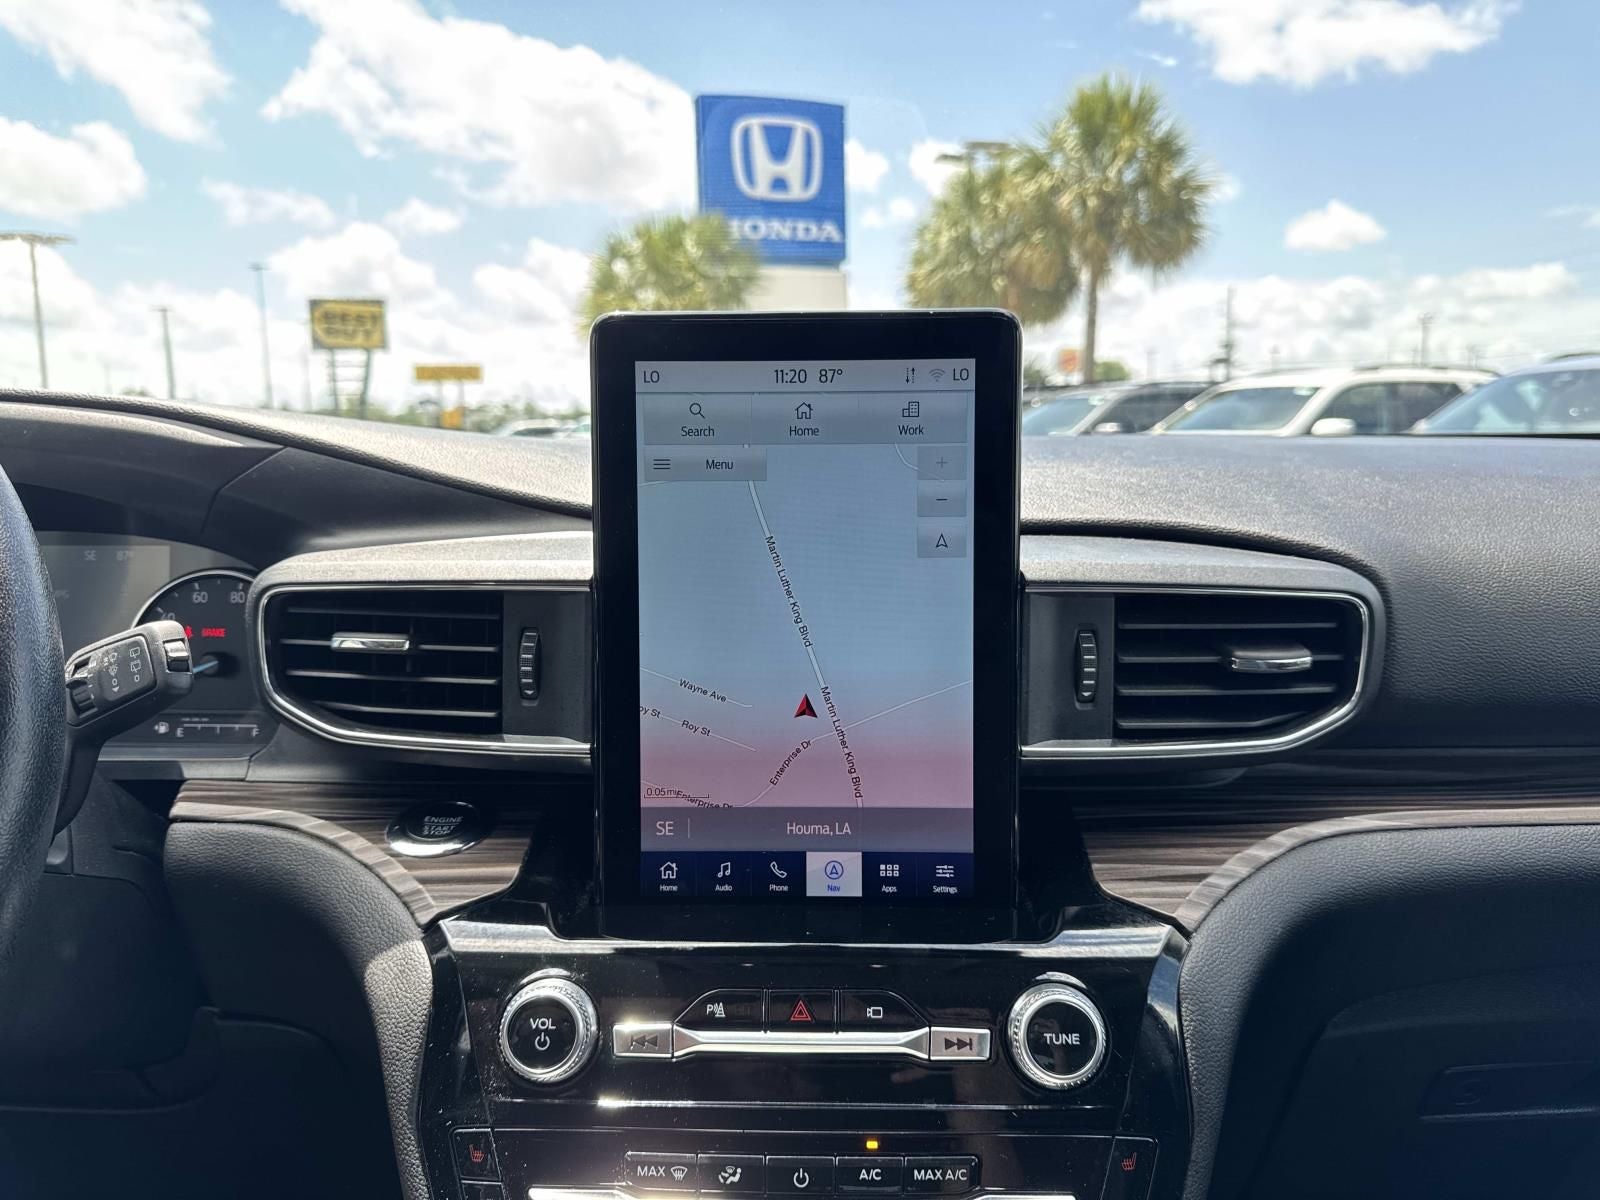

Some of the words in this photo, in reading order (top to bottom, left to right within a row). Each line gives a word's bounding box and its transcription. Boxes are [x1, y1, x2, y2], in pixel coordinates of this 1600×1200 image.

[643, 371, 660, 383] LO
[774, 369, 807, 384] 11:20
[819, 368, 843, 384] 87°
[953, 368, 970, 381] LO
[681, 426, 715, 437] Search
[789, 425, 819, 436] Home
[898, 424, 924, 436] Work
[705, 459, 734, 470] Menu
[192, 591, 209, 603] 60
[230, 591, 246, 604] 80
[765, 535, 782, 568] Martin
[777, 568, 794, 600] Luther
[790, 601, 803, 625] King
[799, 625, 813, 648] Blvd
[679, 678, 708, 694] Wayne
[709, 691, 727, 703] Ave
[640, 705, 650, 715] oy
[651, 708, 661, 719] St
[176, 727, 185, 738] E
[252, 728, 260, 737] F
[681, 720, 699, 733] Roy
[700, 727, 712, 737] St
[821, 686, 837, 718] Martin
[832, 719, 849, 750] Luther
[844, 751, 857, 775] King
[852, 776, 863, 799] Blvd
[769, 746, 802, 786] Enterprise
[801, 740, 812, 750] Dr
[646, 787, 666, 797] 0.05
[424, 815, 464, 823] ENGINE
[656, 821, 675, 836] SE
[786, 822, 833, 836] Houma,
[835, 822, 851, 835] LA
[659, 883, 679, 892] Home
[715, 883, 733, 892] Audio
[769, 883, 789, 892] Phone
[827, 884, 840, 892] Nav
[882, 885, 897, 893] Apps
[932, 885, 958, 894] Settings
[530, 1018, 556, 1030] VOL
[1043, 1033, 1081, 1045] TUNE
[637, 1165, 665, 1177] MAX
[859, 1168, 882, 1181] A/C
[913, 1169, 943, 1181] MAX
[944, 1169, 968, 1181] A/C
